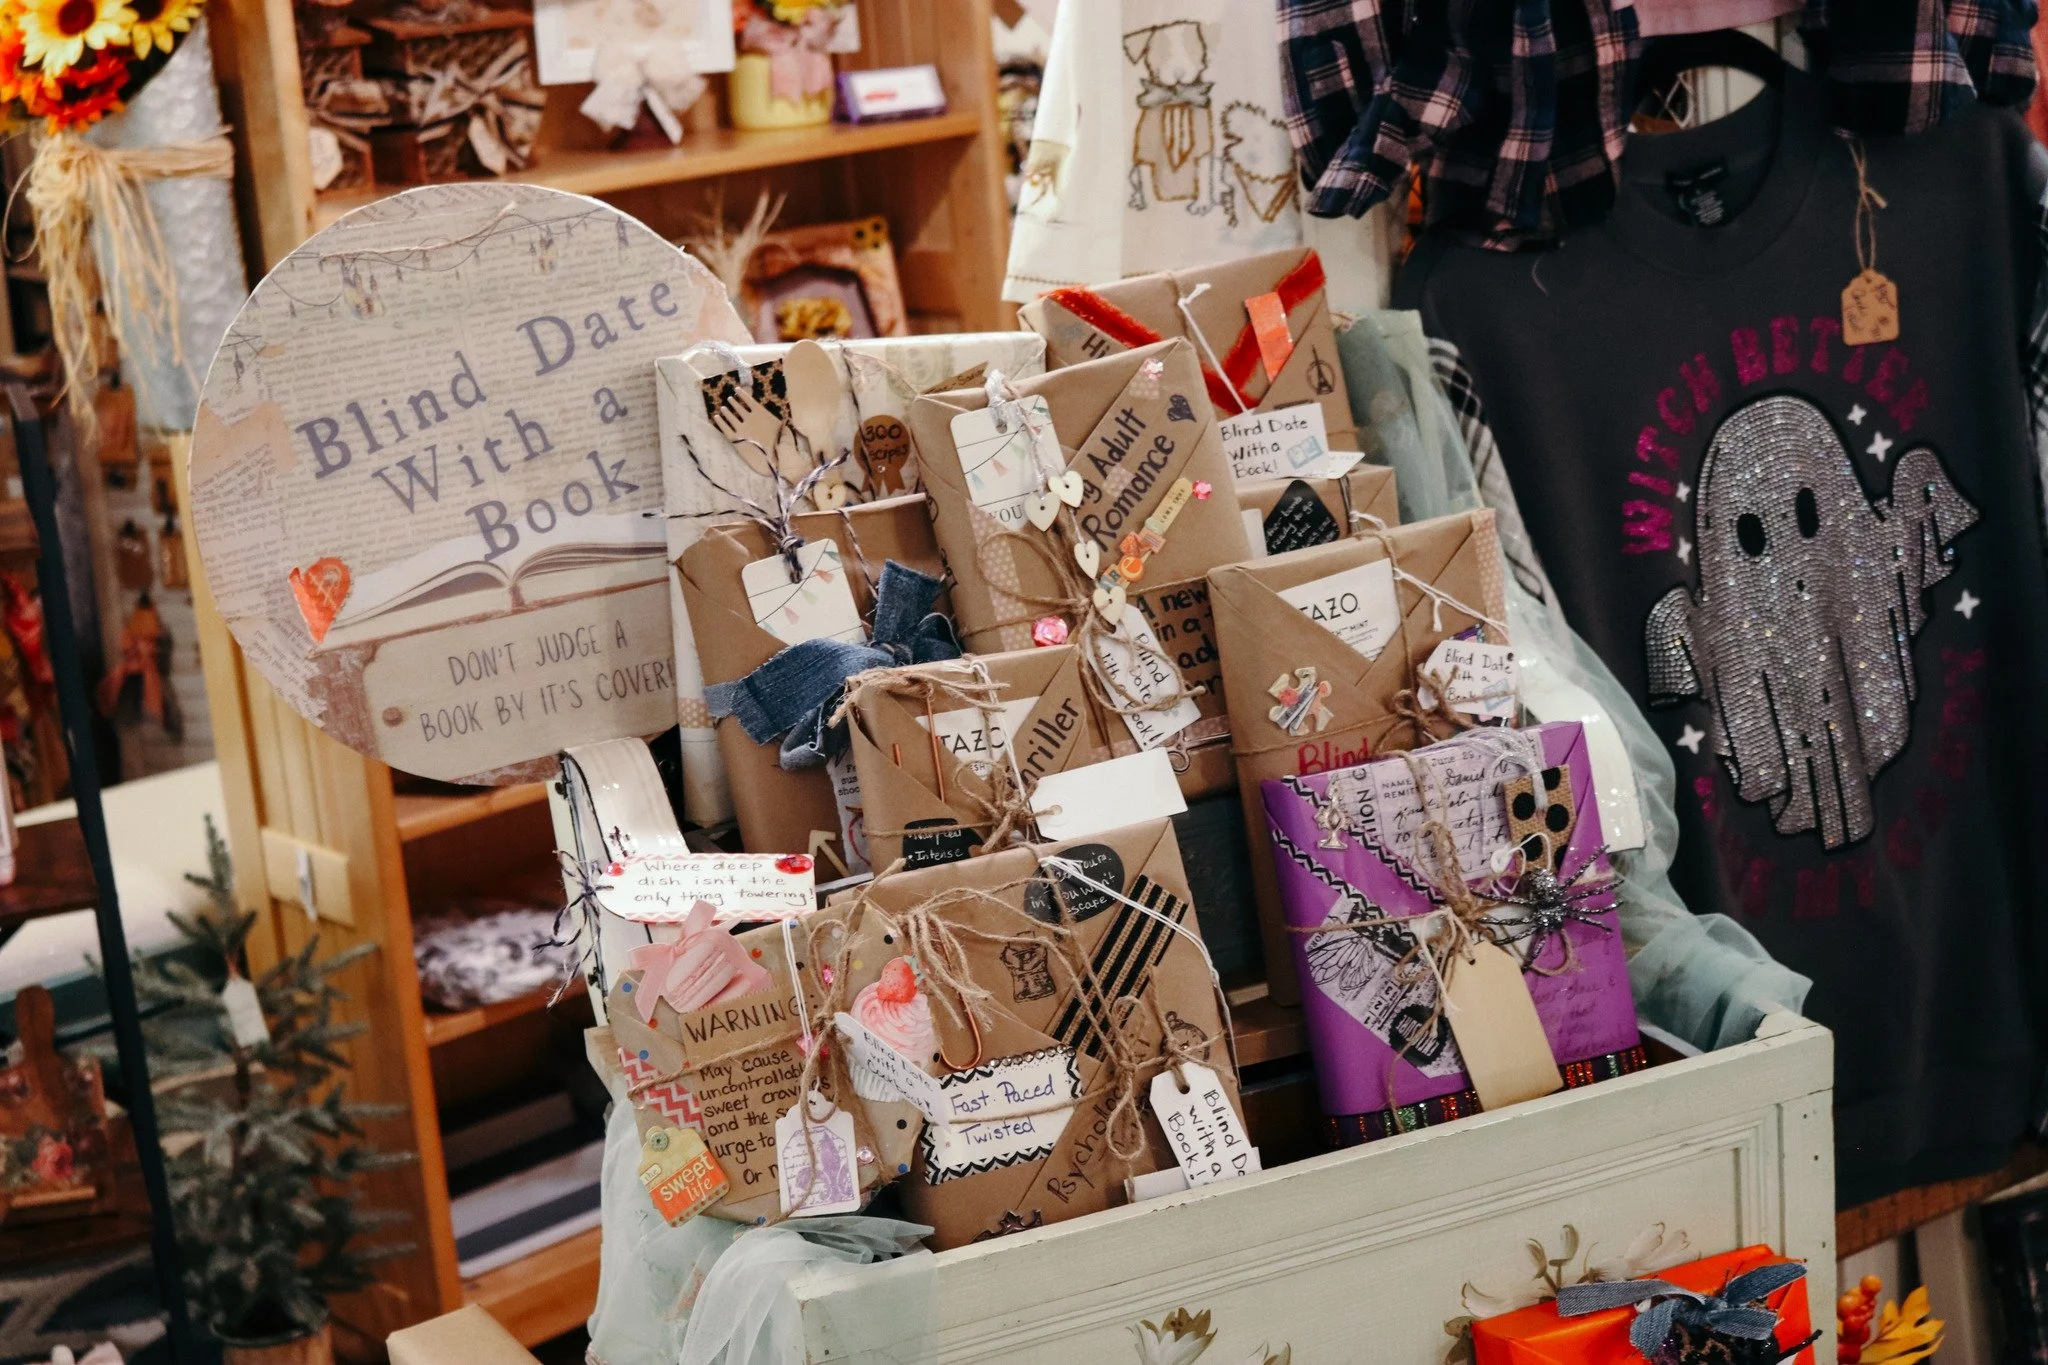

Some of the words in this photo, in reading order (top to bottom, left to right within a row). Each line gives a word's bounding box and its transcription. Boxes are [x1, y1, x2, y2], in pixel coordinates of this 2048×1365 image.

[296, 350, 487, 479] Blind
[516, 280, 679, 377] Date
[863, 423, 901, 443] 300
[1220, 419, 1263, 442] Blind
[1268, 413, 1309, 434] Date
[371, 408, 555, 515] With
[592, 386, 629, 425] a
[866, 443, 909, 465] ecipes
[1086, 407, 1147, 480] Adult
[1621, 352, 1722, 555] WITCH
[1232, 459, 1278, 479] Book!
[464, 449, 640, 561] Book
[1080, 434, 1176, 553] Romance
[1299, 592, 1359, 622] AZO
[447, 642, 518, 687] DON'T
[535, 624, 602, 668] JUDGE
[614, 619, 629, 650] A
[1444, 648, 1474, 667] Blind
[1481, 653, 1514, 675] Date
[419, 701, 484, 743] BOOK
[494, 690, 526, 726] BY
[539, 679, 584, 716] IT'S
[595, 657, 677, 702] COVER!
[1297, 736, 1370, 775] Blind
[1381, 777, 1413, 790] NAME
[1383, 782, 1435, 800] REMITER
[643, 861, 701, 872] Where
[712, 861, 763, 872] deep
[914, 845, 965, 862] Intense
[637, 876, 680, 887] dish
[694, 875, 739, 886] isn't
[747, 875, 788, 887] the
[634, 890, 671, 907] only
[679, 891, 725, 907] thing
[734, 887, 816, 907] towering!
[699, 1063, 732, 1082] May
[741, 1050, 794, 1074] cause
[700, 1062, 808, 1102] uncontrollabl
[996, 1073, 1056, 1104] Paced
[703, 1094, 751, 1118] sweet
[1202, 1088, 1242, 1148] Blind
[707, 1115, 740, 1138] and
[747, 1107, 771, 1127] the
[958, 1116, 1036, 1145] Twisted
[758, 1131, 777, 1149] to
[1167, 1110, 1208, 1181] Book!
[1188, 1103, 1216, 1157] with
[1210, 1161, 1223, 1178] a
[642, 1166, 660, 1184] the
[659, 1154, 715, 1202] sweet
[743, 1169, 763, 1187] Or
[685, 1178, 714, 1204] life
